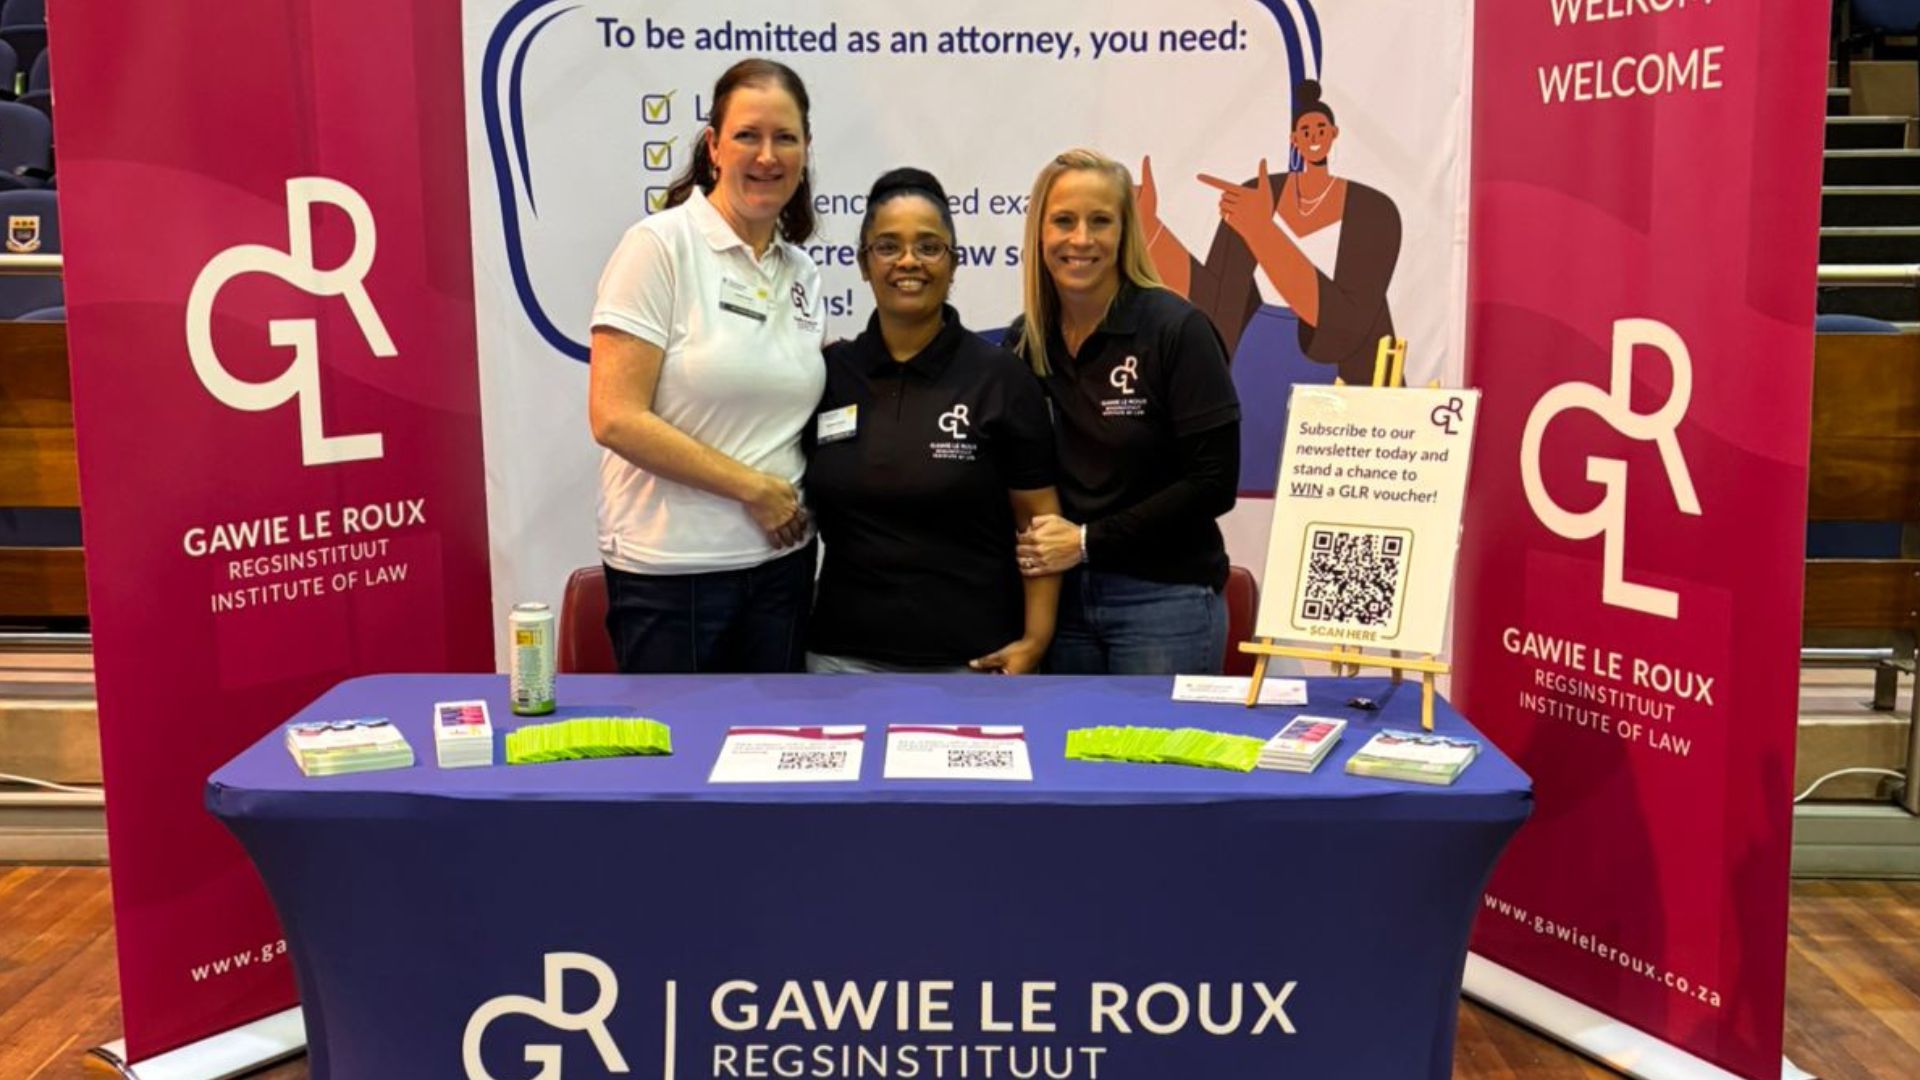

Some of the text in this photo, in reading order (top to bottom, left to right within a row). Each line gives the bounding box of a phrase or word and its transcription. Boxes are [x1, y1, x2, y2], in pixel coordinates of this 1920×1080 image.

[595, 17, 1248, 59] To be admitted as an attorney, you need:
[1538, 45, 1725, 104] WELCOME
[1296, 442, 1449, 463] newsletter today and
[1299, 421, 1416, 440] Subscribe to our
[1289, 481, 1438, 504] WIN a GLR voucher!
[1293, 463, 1418, 482] stand a chance to
[183, 498, 427, 557] GAWIE LE ROUX
[229, 538, 390, 581] REGSINSTITUUT
[210, 563, 409, 614] INSTITUTE OF LAW
[1309, 624, 1378, 641] SCAN HERE
[1502, 627, 1715, 706] GAWIE LE ROUX
[1535, 668, 1676, 723] REGSINSTITUUT
[1519, 691, 1692, 758] INSTITUTE OF LAW
[190, 938, 287, 982] www.ga
[1483, 892, 1722, 1008] www.gawieleroux.co.za
[711, 979, 1299, 1036] GAWIE LE ROUX
[713, 1043, 1108, 1080] REGSINSTITUUT
